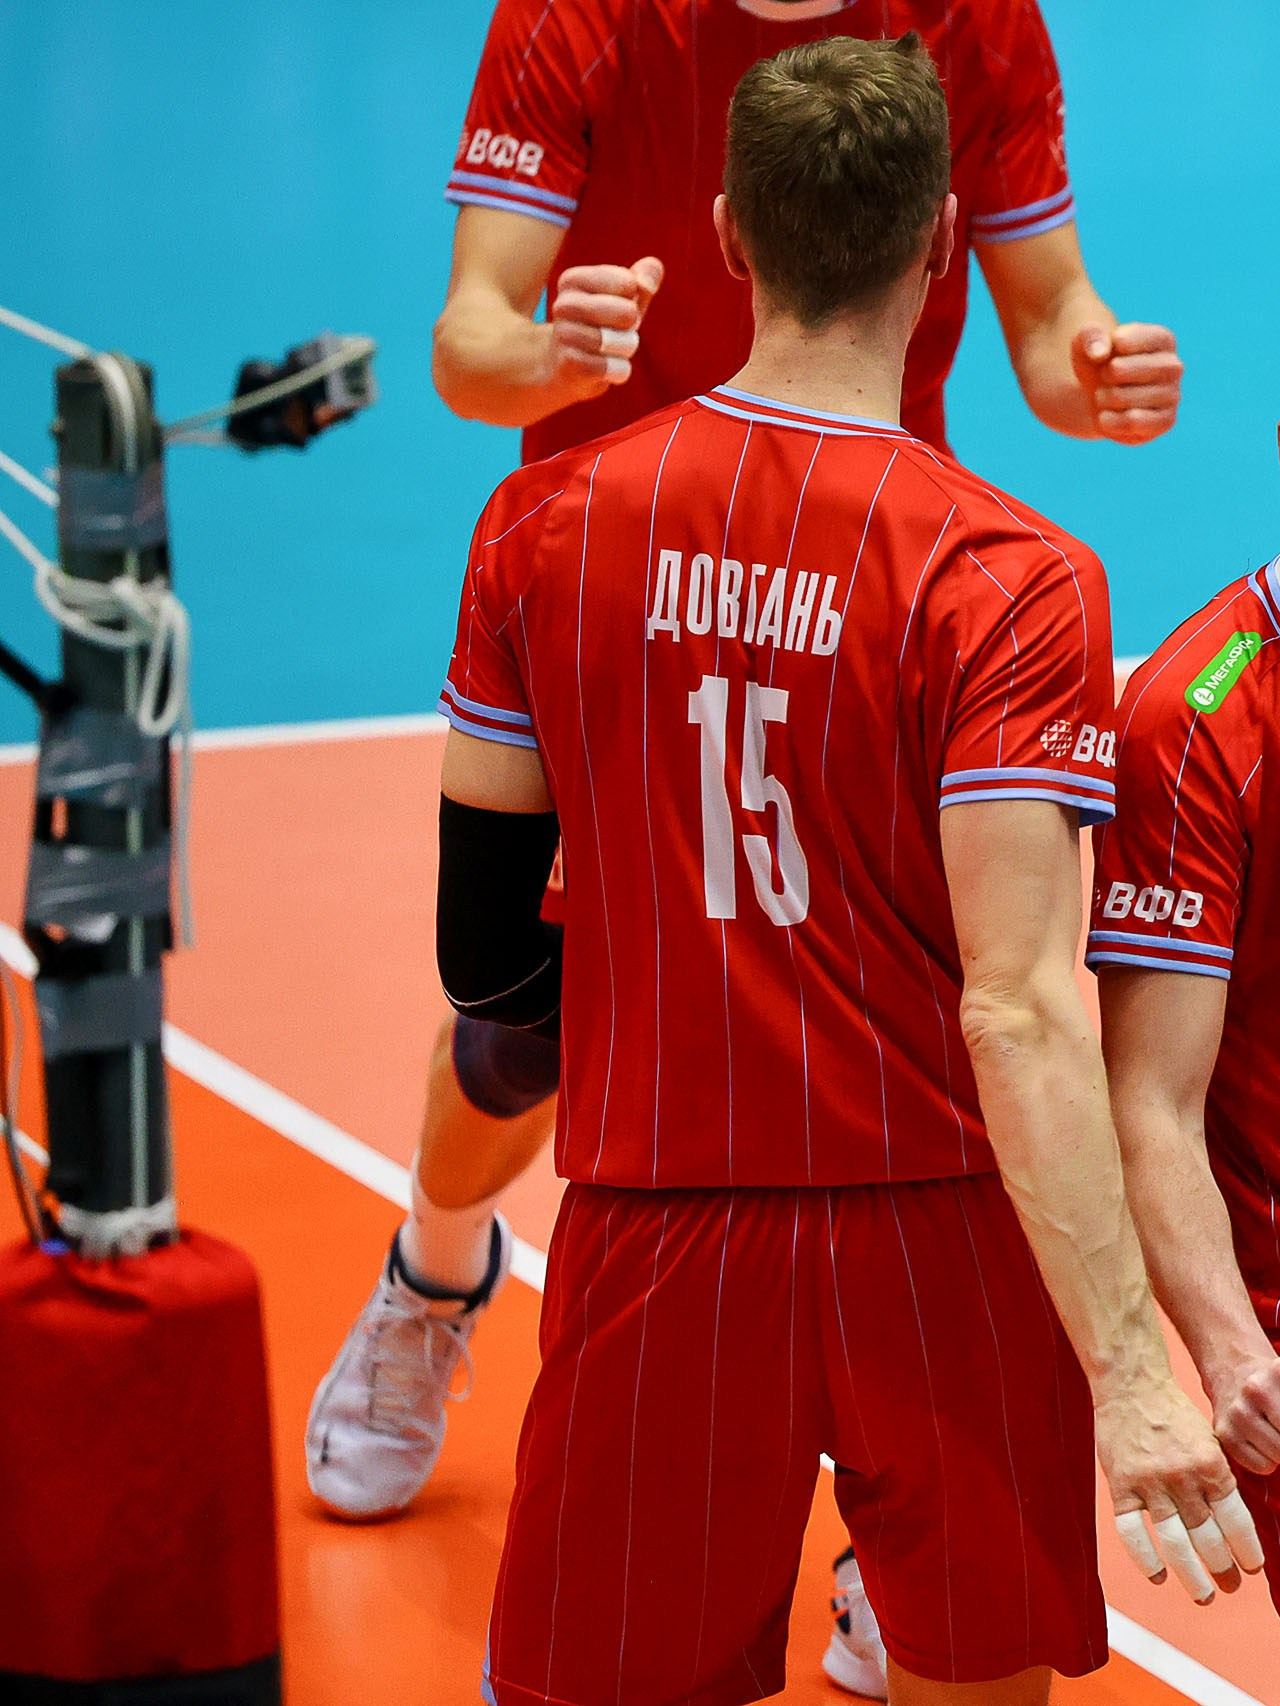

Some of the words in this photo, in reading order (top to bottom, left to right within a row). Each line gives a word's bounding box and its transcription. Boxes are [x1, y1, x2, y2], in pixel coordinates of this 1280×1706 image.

[465, 128, 544, 176] ВФВ
[647, 549, 843, 656] ДОВГАНЬ
[688, 675, 809, 926] 15
[1102, 881, 1204, 928] ВФВ
